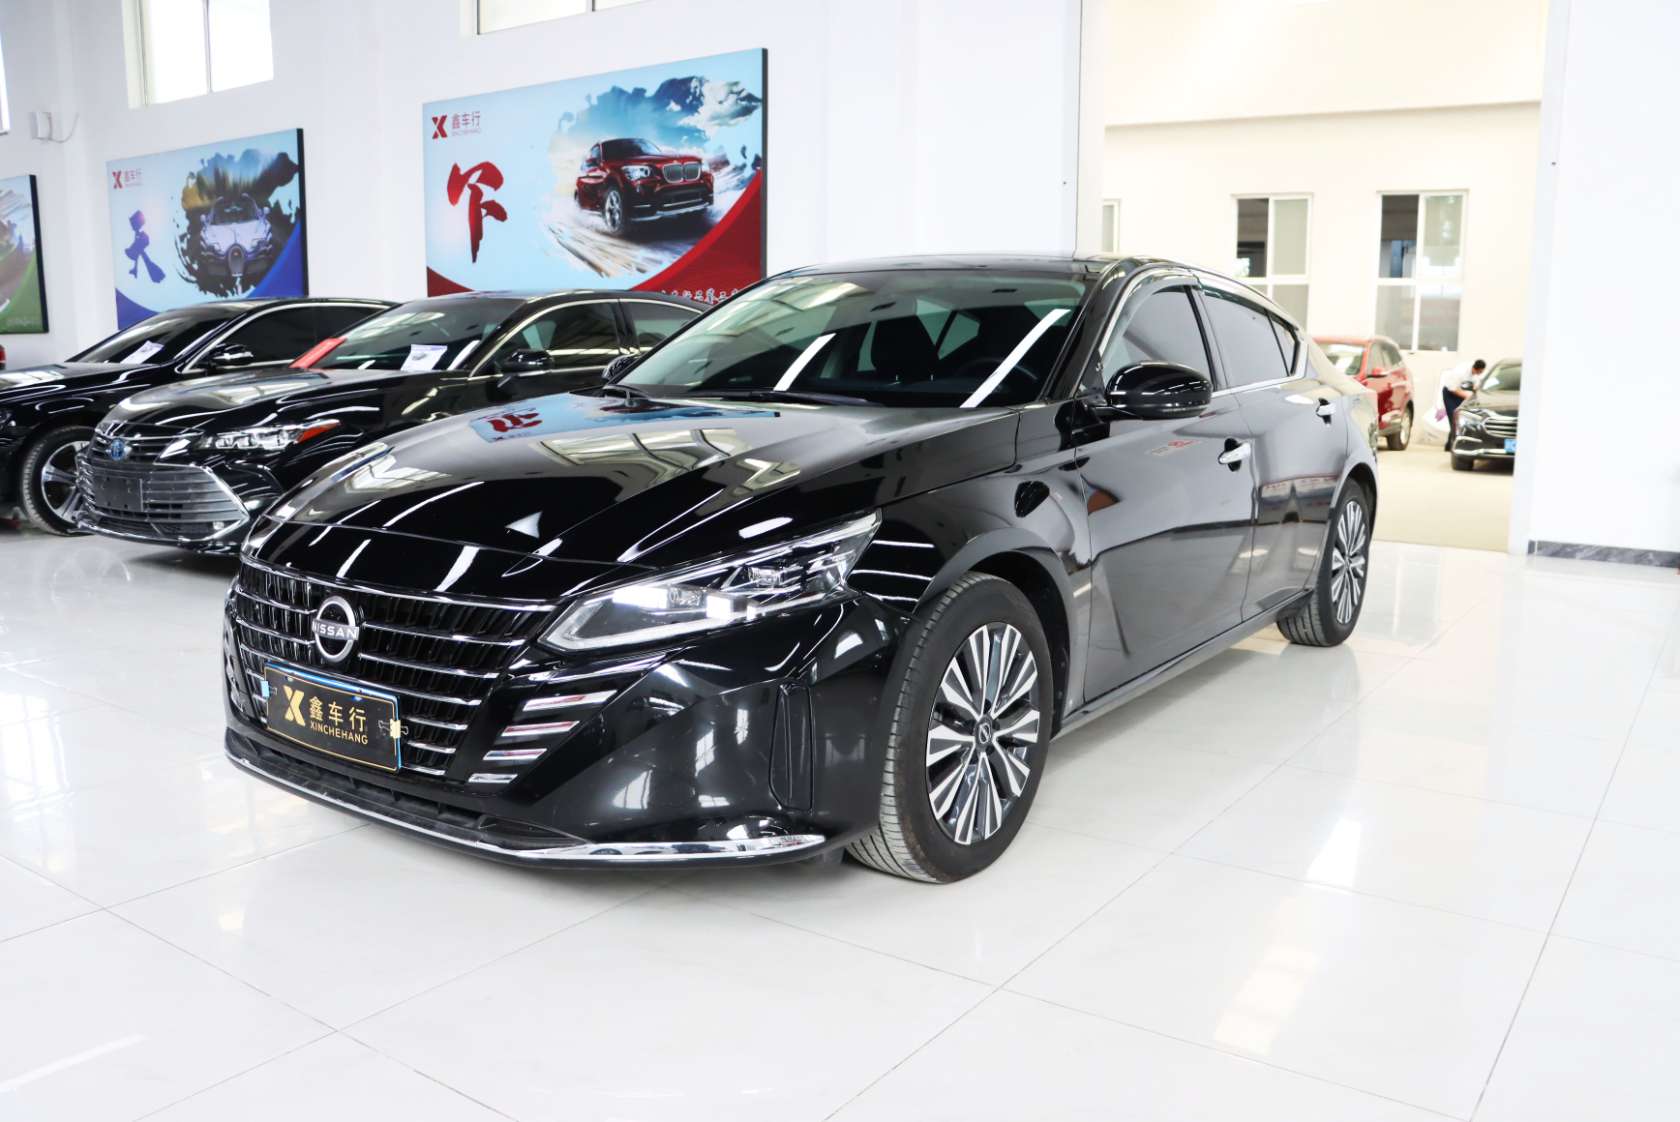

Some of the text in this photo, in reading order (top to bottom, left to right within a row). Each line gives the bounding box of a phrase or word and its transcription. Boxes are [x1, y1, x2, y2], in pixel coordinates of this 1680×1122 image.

[312, 620, 358, 640] NISSAN
[309, 696, 367, 732] 鑫车行
[310, 721, 368, 745] XINCHEHANG
